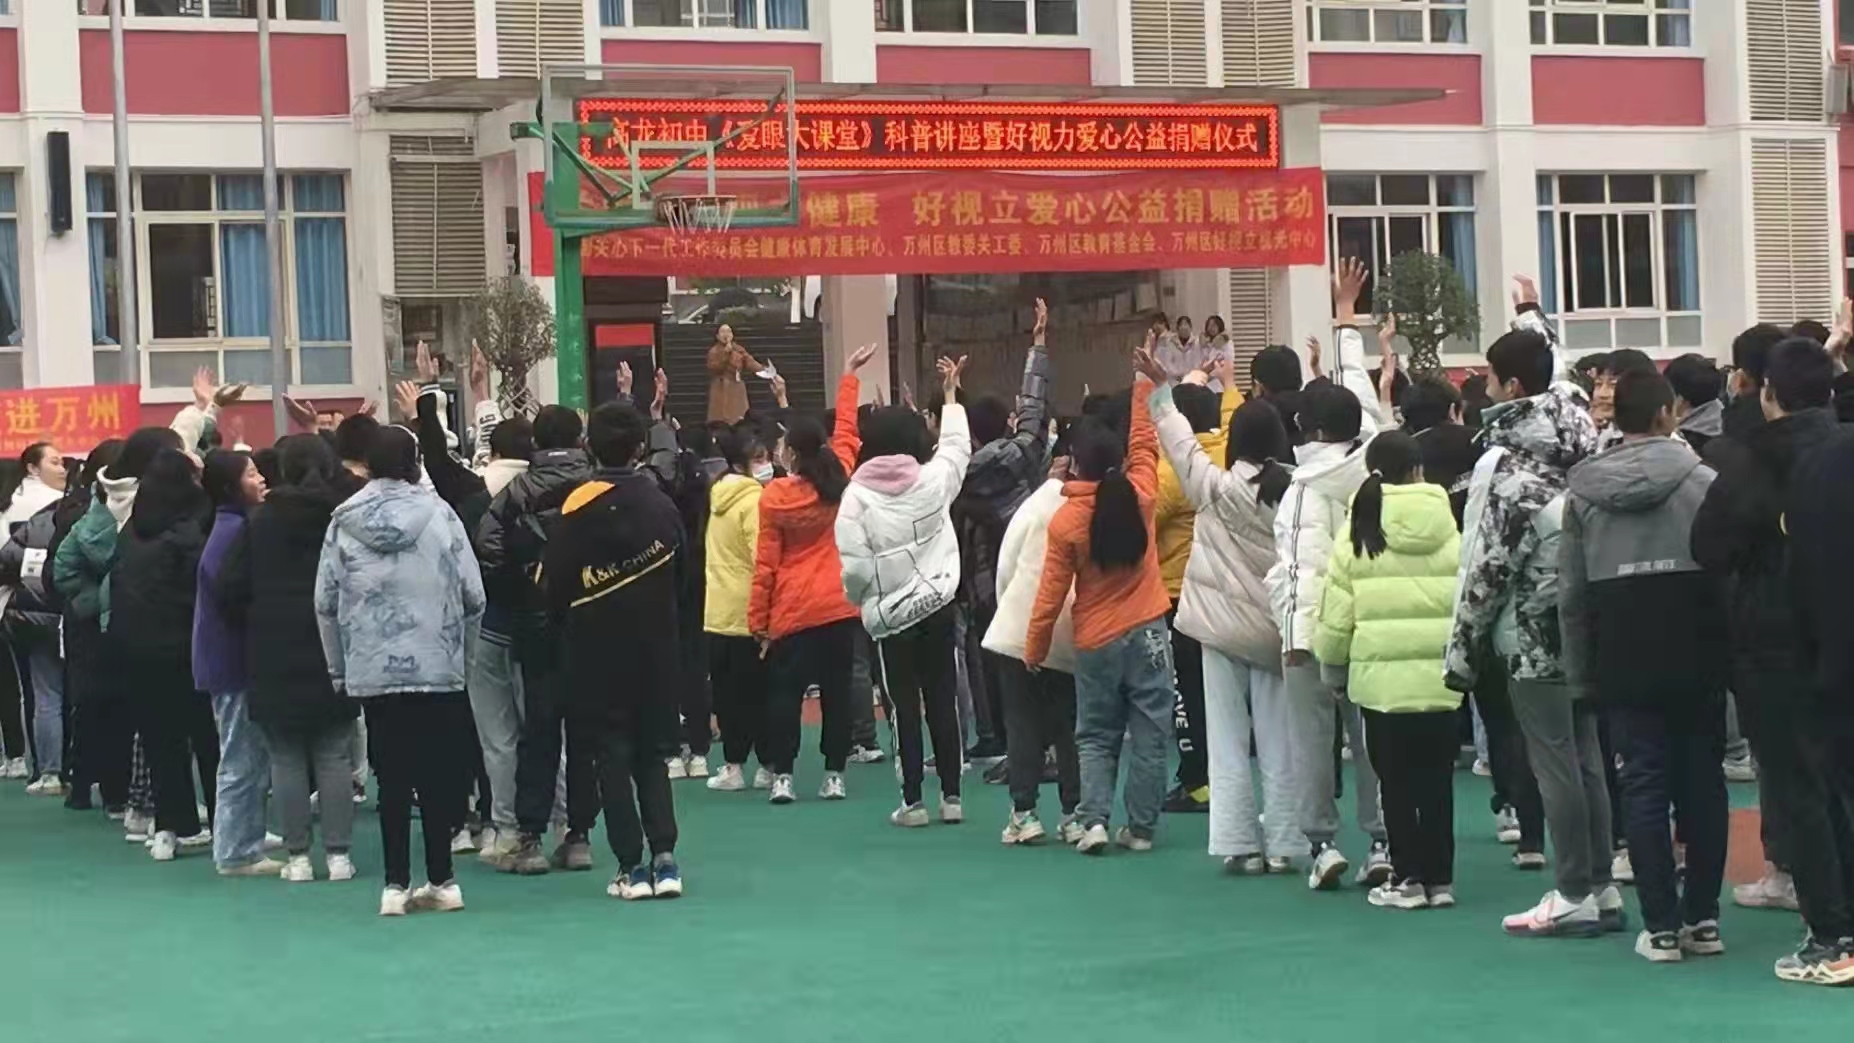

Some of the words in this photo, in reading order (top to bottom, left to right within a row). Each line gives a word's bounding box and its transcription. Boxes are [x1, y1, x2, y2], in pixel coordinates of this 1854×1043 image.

[912, 187, 1314, 227] 好视立爱心公益捐赠活动
[622, 540, 665, 570] CHINA
